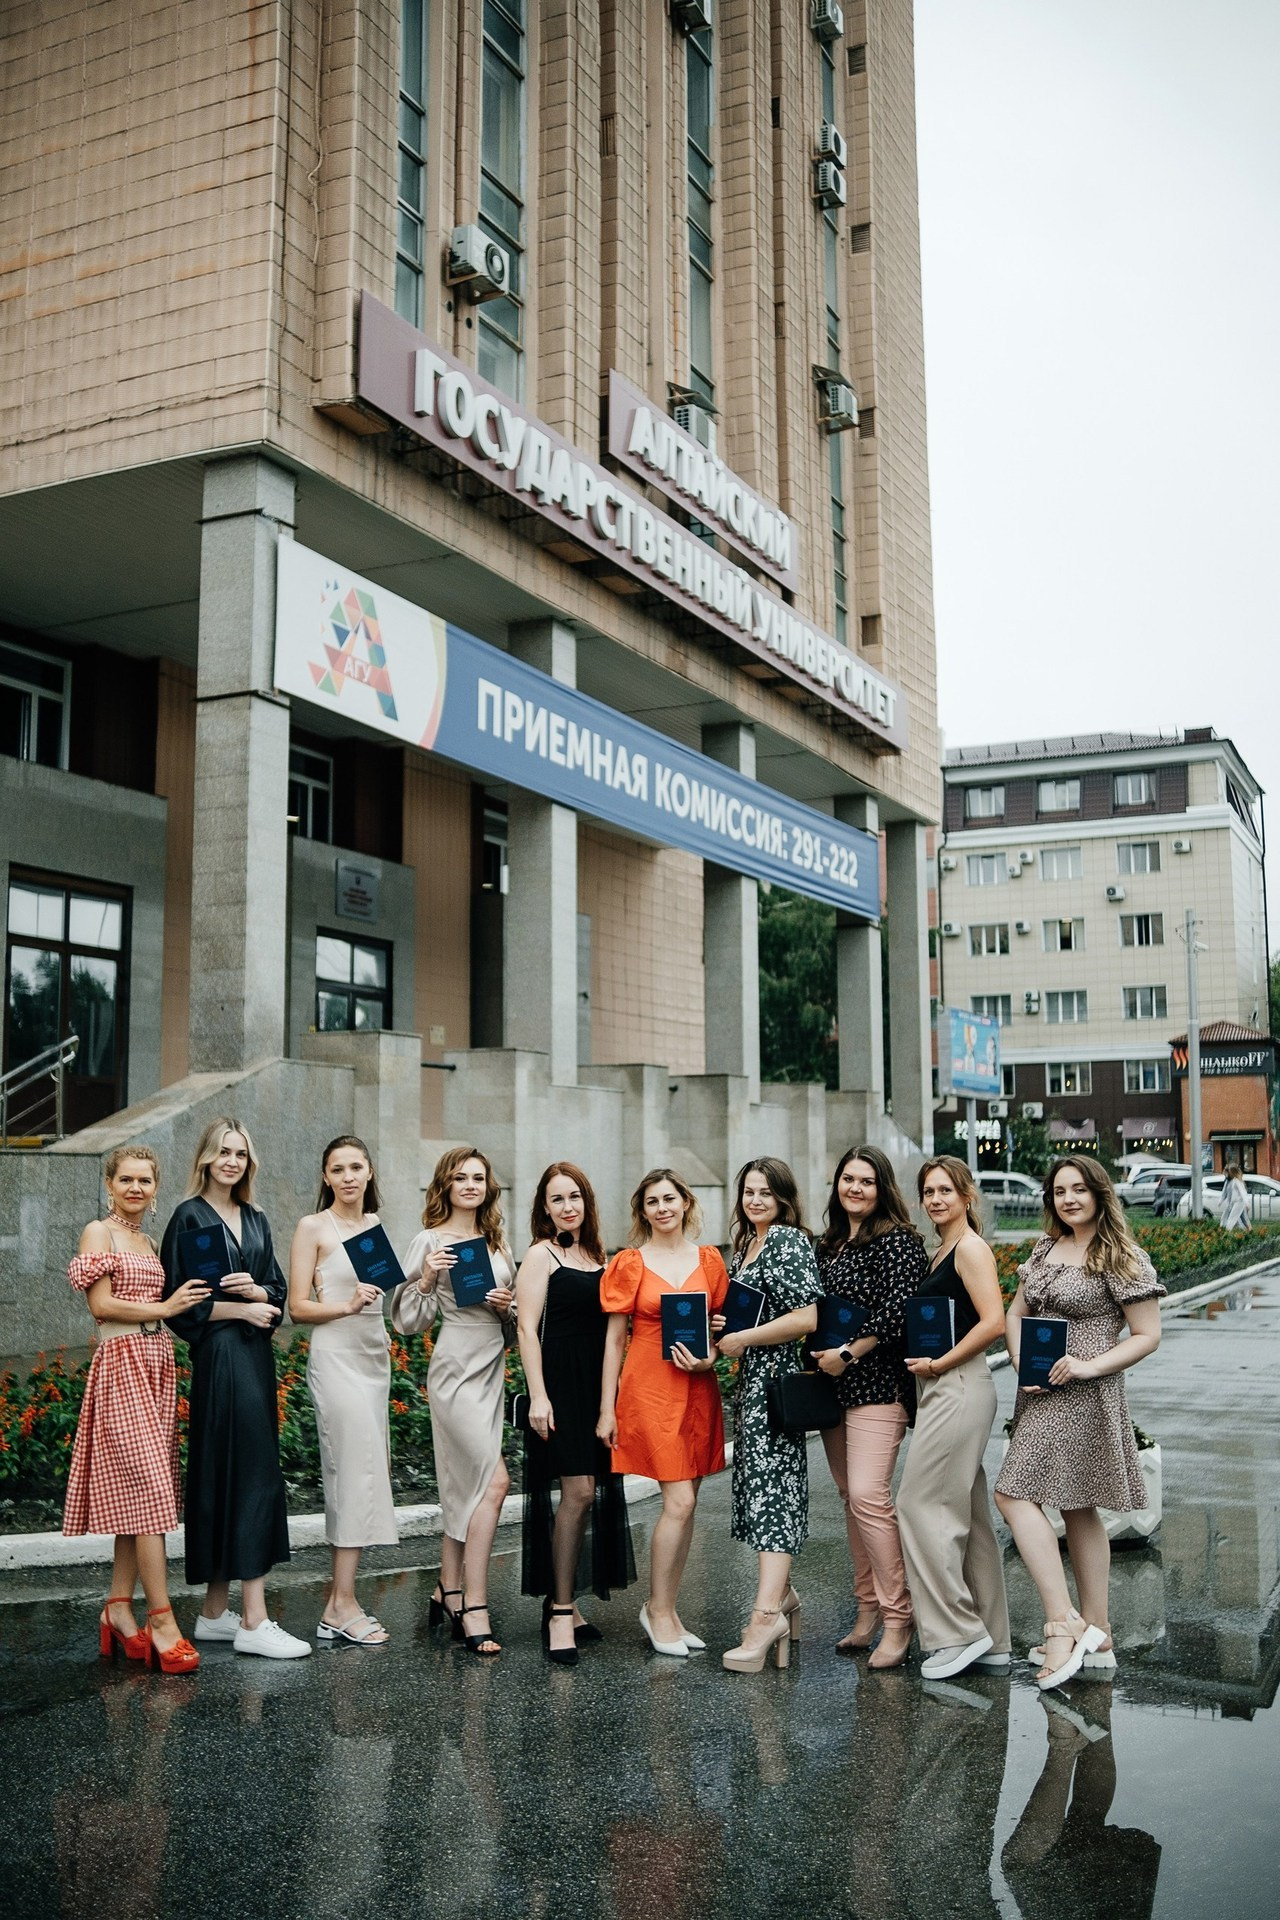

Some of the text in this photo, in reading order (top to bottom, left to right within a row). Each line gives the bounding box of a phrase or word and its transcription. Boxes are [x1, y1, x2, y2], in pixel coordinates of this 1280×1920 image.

[414, 348, 897, 729] ГОСУДАРСТВЕННЫЙ УНИВЕРСИТЕТ
[628, 406, 793, 572] АЛТАЙСКИЙ
[344, 655, 372, 682] АГУ
[477, 677, 859, 889] ПРИЕМНАЯ КОМИССИЯ: 291-222
